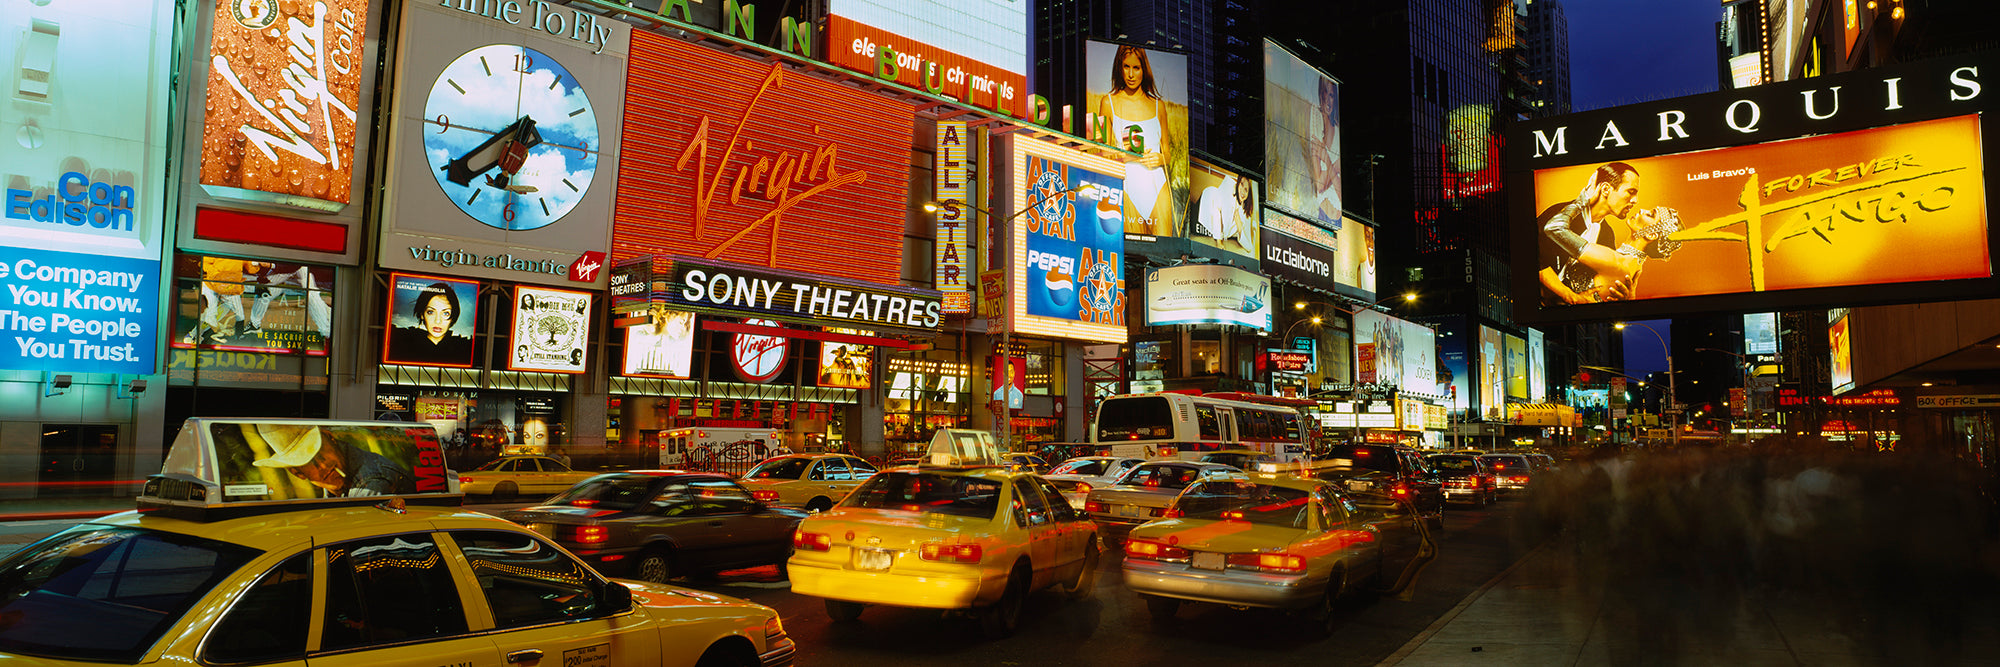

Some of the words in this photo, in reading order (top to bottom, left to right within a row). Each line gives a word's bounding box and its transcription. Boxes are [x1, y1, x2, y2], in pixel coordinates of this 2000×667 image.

[330, 8, 355, 75] Cola
[440, 0, 522, 24] me
[529, 0, 566, 36] To
[571, 10, 612, 54] Fly
[513, 54, 533, 75] 12
[621, 0, 810, 57] ANN
[879, 46, 1146, 153] BUILDING
[213, 1, 357, 171] Virgin
[436, 114, 449, 135] 9
[1532, 66, 1982, 159] MARQUIS
[578, 141, 589, 161] 3
[677, 61, 868, 268] Virgin
[941, 125, 961, 190] ALL
[1687, 172, 1711, 182] Luis
[1713, 166, 1756, 179] Bravo's
[1762, 153, 1923, 199] FOREVER
[58, 171, 135, 209] Con
[1079, 180, 1123, 206] PEPSI
[5, 188, 134, 232] Edison
[502, 202, 515, 222] 6
[941, 198, 961, 286] STAR
[15, 259, 143, 291] Company
[409, 244, 480, 268] virgin
[484, 251, 567, 276] atlantic
[575, 255, 601, 280] Virgin
[1027, 250, 1075, 275] PEPSI
[1283, 247, 1330, 277] claiborne
[611, 274, 629, 286] SONY
[611, 282, 644, 296] THEATRES
[1172, 278, 1190, 286] Great
[7, 284, 61, 309] You
[63, 287, 143, 314] Know.
[682, 269, 784, 309] SONY
[790, 283, 942, 329] THEATRES
[0, 309, 46, 333] The
[51, 313, 141, 341] People
[273, 332, 320, 343] SACRIFCE.
[15, 336, 65, 360] You
[68, 339, 140, 362] Trust.
[1917, 397, 1936, 406] BOX
[1938, 396, 1977, 406] OFFICE
[404, 427, 447, 493] Marl
